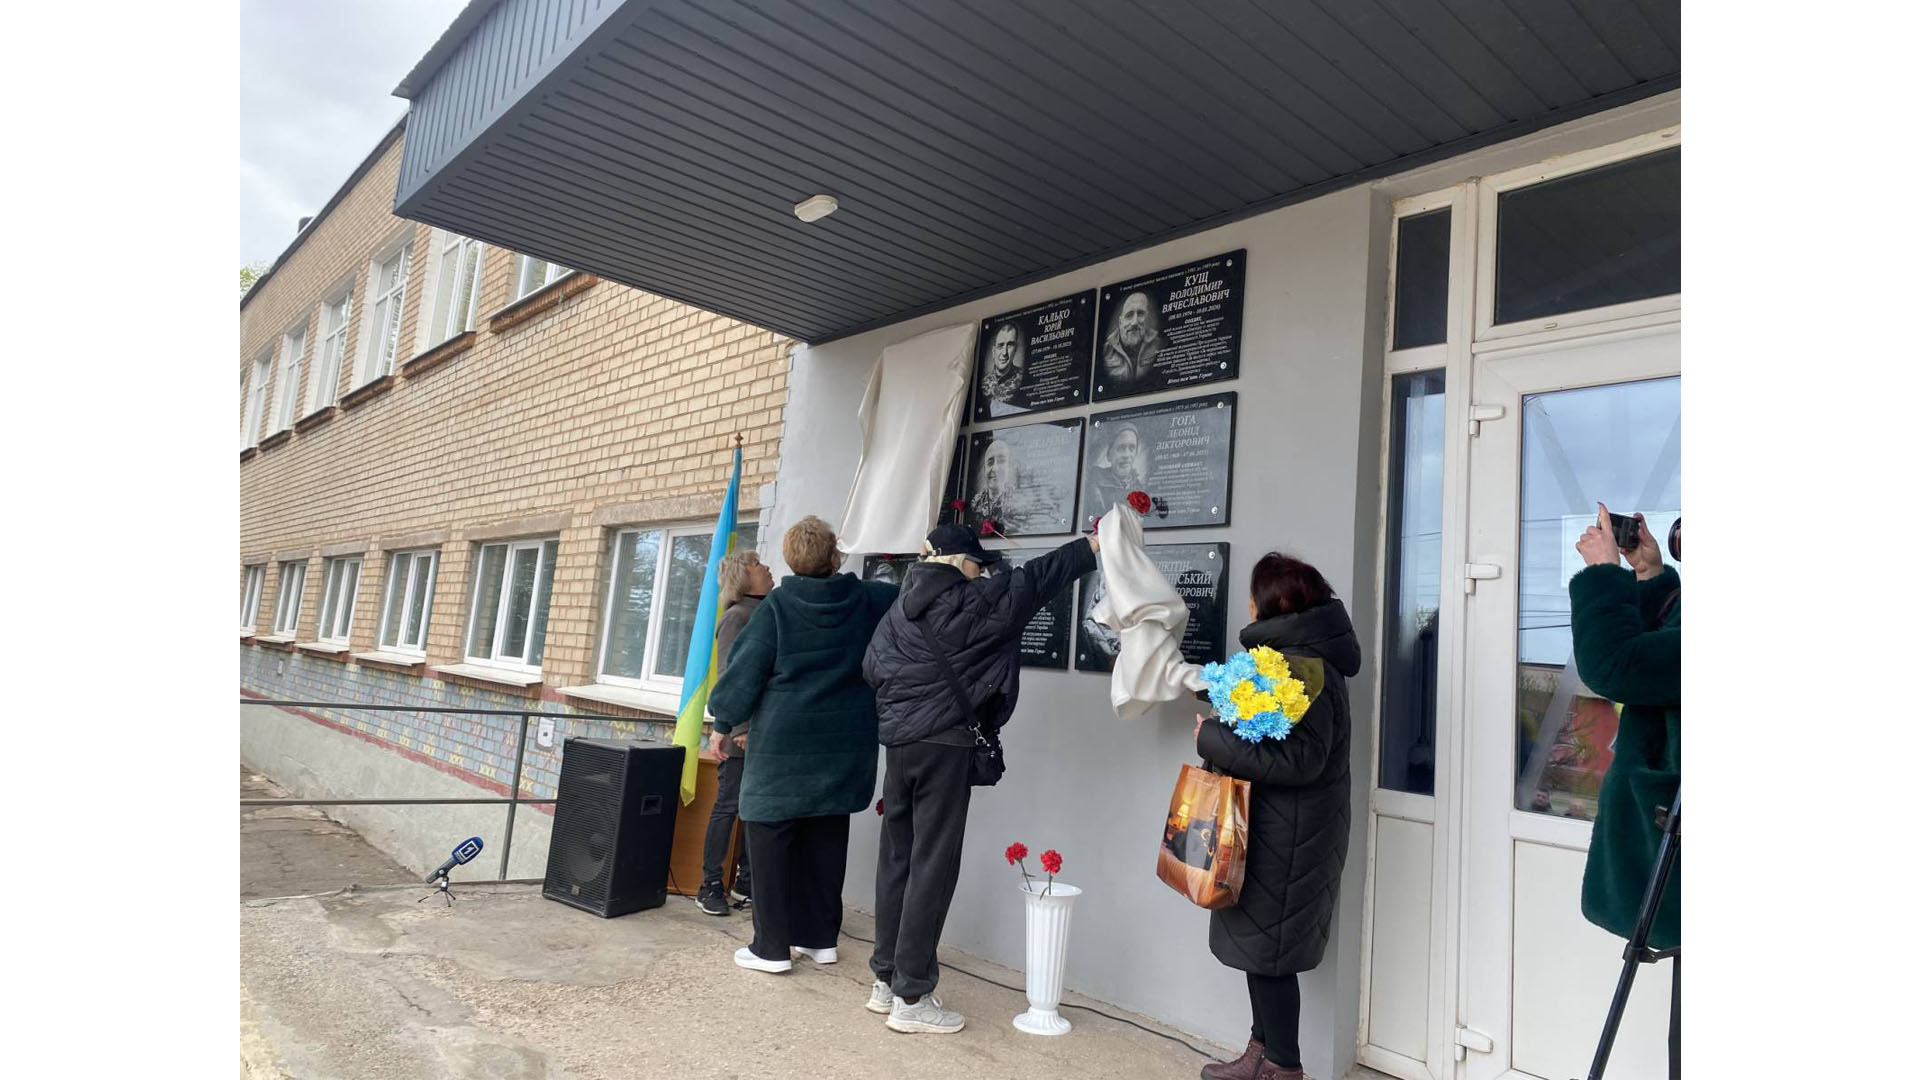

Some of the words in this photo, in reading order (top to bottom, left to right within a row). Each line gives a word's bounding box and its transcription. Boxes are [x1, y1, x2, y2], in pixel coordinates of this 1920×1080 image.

[1184, 271, 1209, 287] КУЩ
[1169, 280, 1223, 301] ВОЛОДИМИР
[1162, 289, 1230, 313] ВЯЧЕСЛАВОВИЧ
[1038, 308, 1071, 326] КАЛЬКО
[1044, 320, 1062, 333] ЮРІЙ
[1030, 327, 1075, 345] ВАСИЛЬОВИЧ
[1171, 415, 1196, 427] ГОГА
[1169, 426, 1200, 438] ЛЕОНІД
[1156, 435, 1210, 450] ВІКТОРОВИЧ
